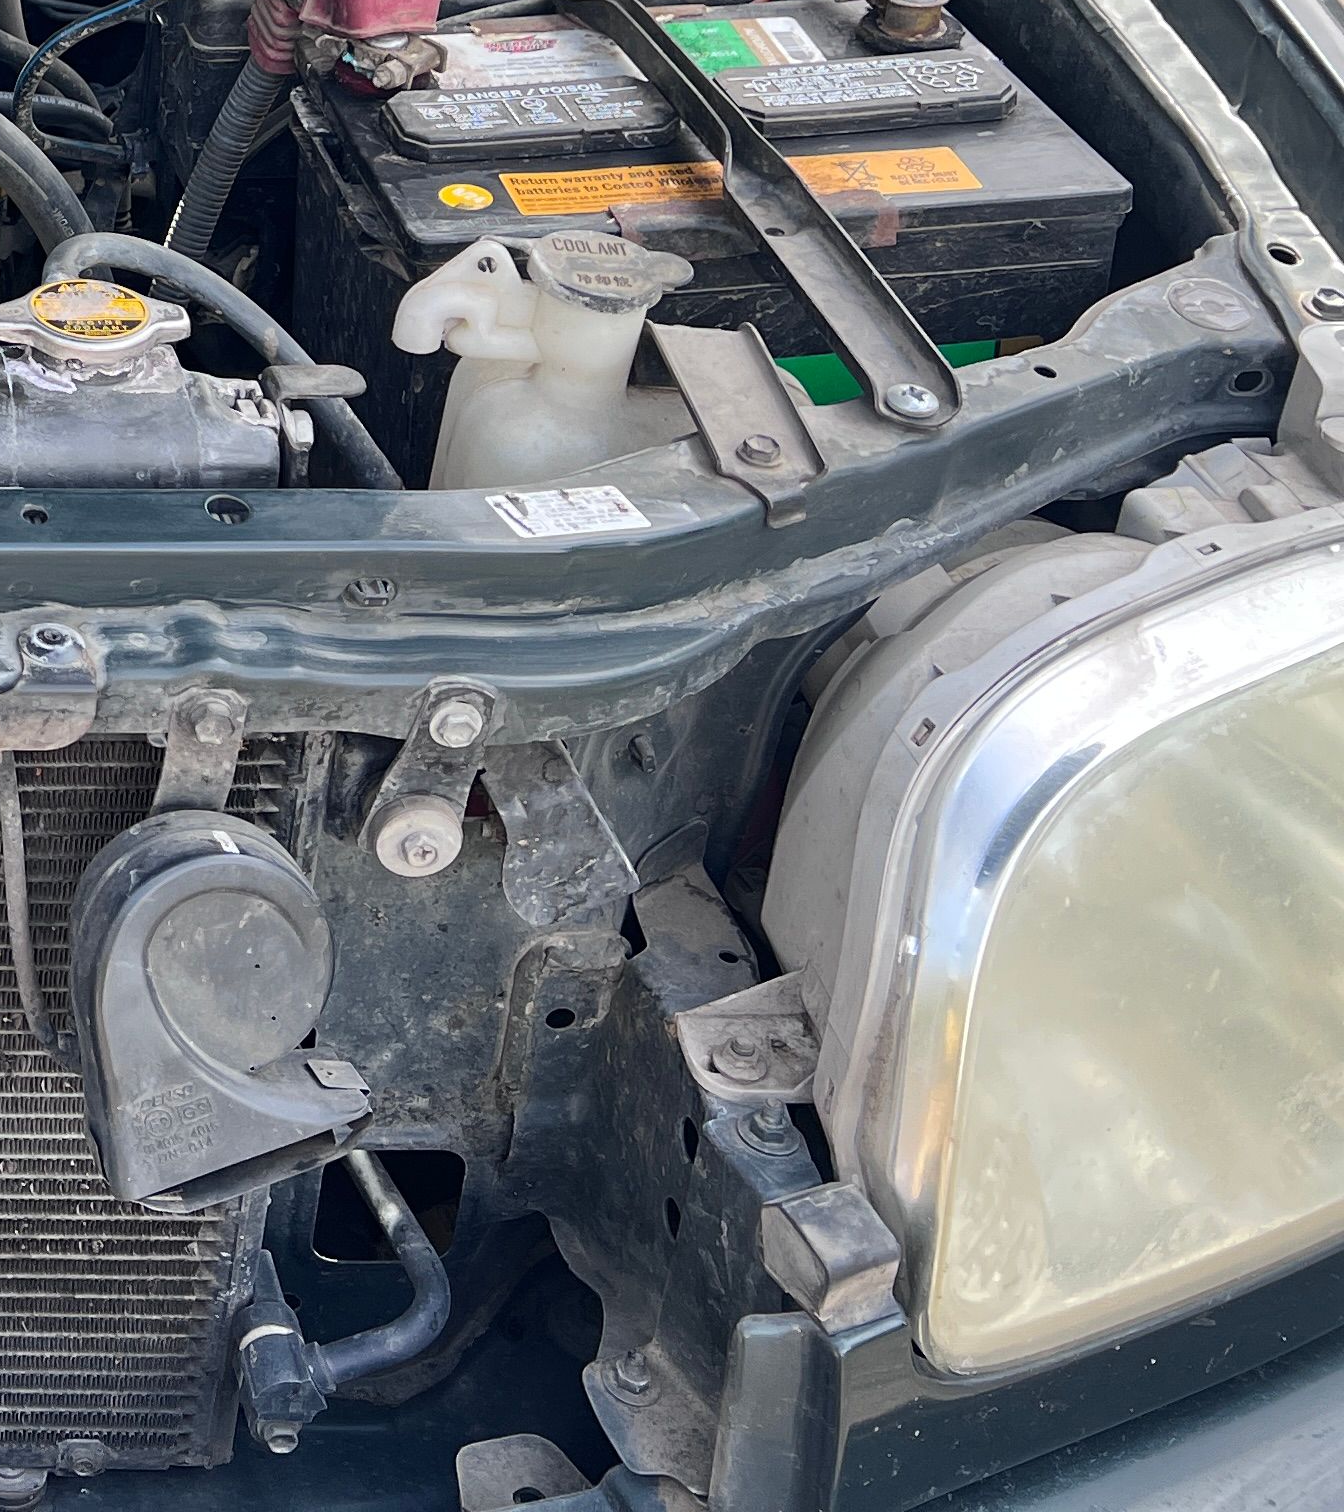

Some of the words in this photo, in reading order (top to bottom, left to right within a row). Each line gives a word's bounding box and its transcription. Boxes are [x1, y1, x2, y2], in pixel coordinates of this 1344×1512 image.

[453, 89, 522, 102] DANGER
[525, 87, 537, 98] /
[539, 82, 602, 96] POISON
[510, 176, 558, 187] Return
[561, 172, 624, 185] warranty
[628, 169, 657, 179] and
[658, 166, 695, 177] used
[515, 184, 582, 196] batteries
[585, 184, 600, 193] to
[602, 180, 653, 191] Costco
[657, 174, 722, 189] Wholesal
[552, 237, 628, 257] COOLANT
